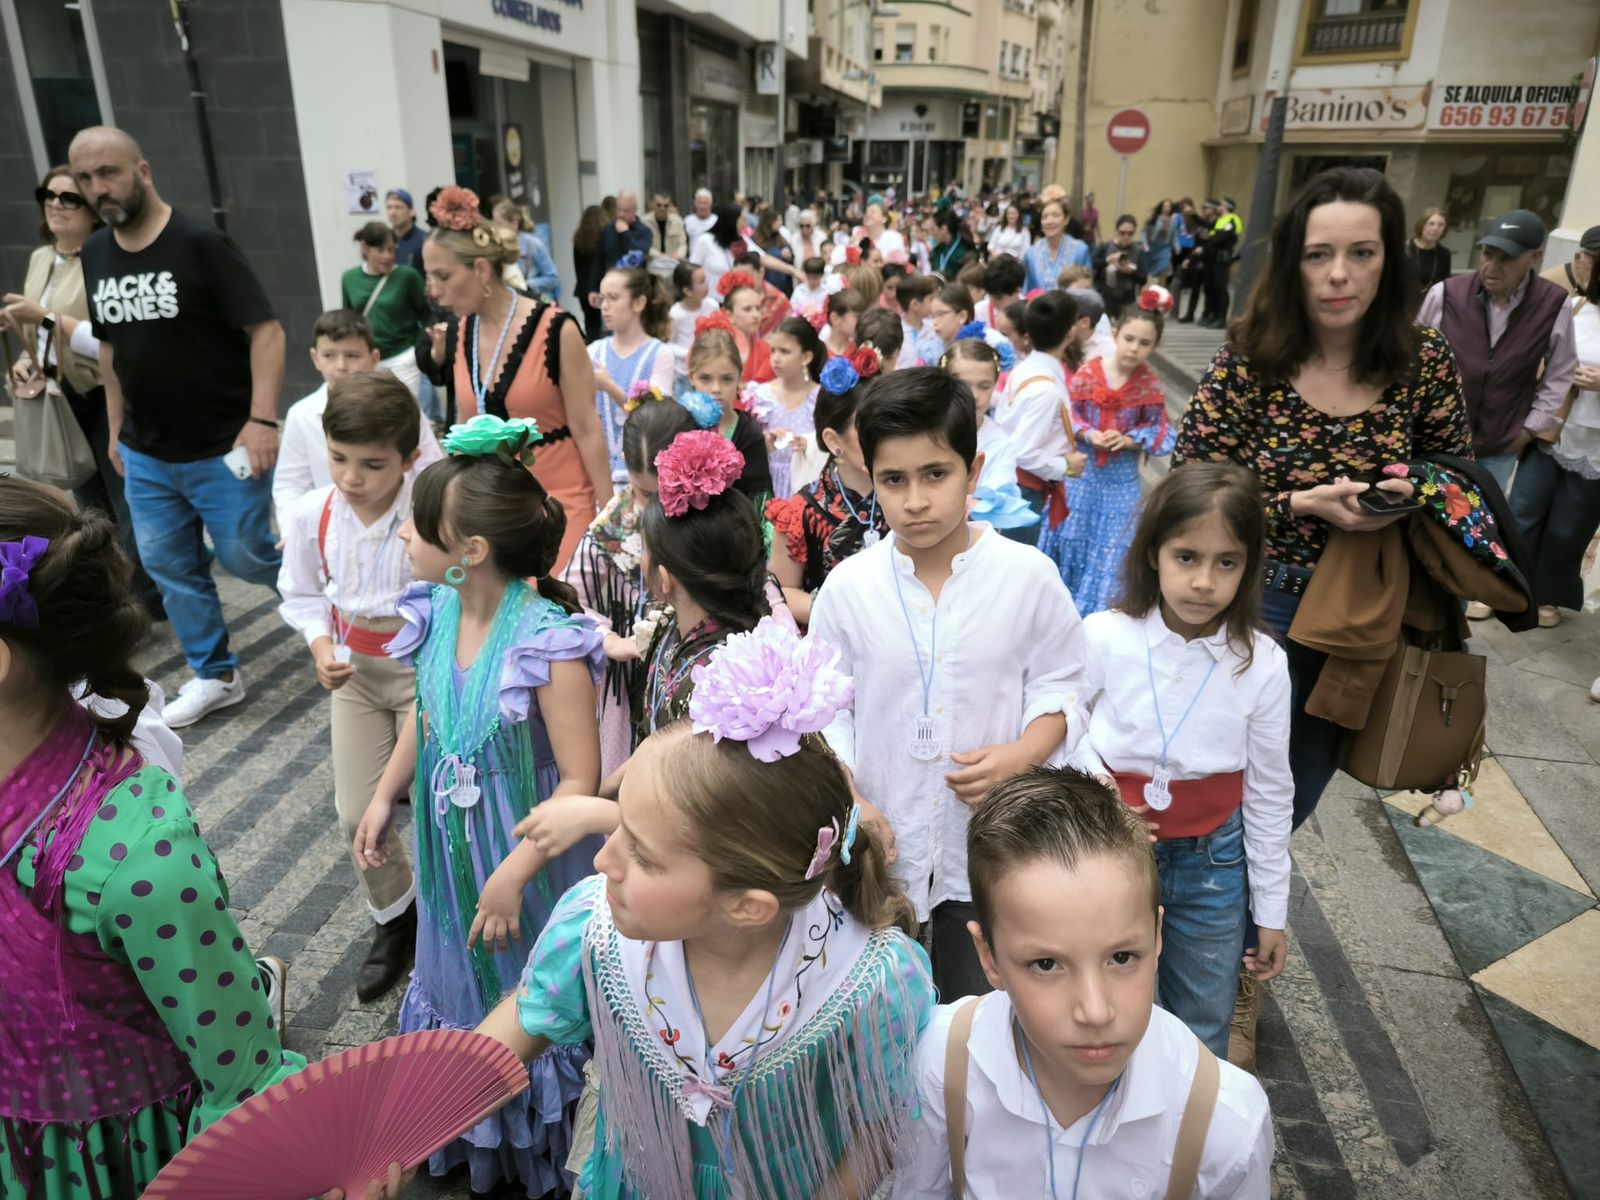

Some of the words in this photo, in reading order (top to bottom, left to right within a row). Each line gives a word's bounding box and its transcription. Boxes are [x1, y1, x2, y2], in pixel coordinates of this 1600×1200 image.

[760, 49, 776, 80] R
[1444, 86, 1462, 103] SE
[1464, 86, 1522, 104] ALQUILA
[1525, 86, 1580, 104] OFICIN
[1287, 95, 1407, 122] Banino's
[1439, 106, 1483, 126] 656
[1488, 106, 1517, 126] 93
[1521, 106, 1548, 126] 67
